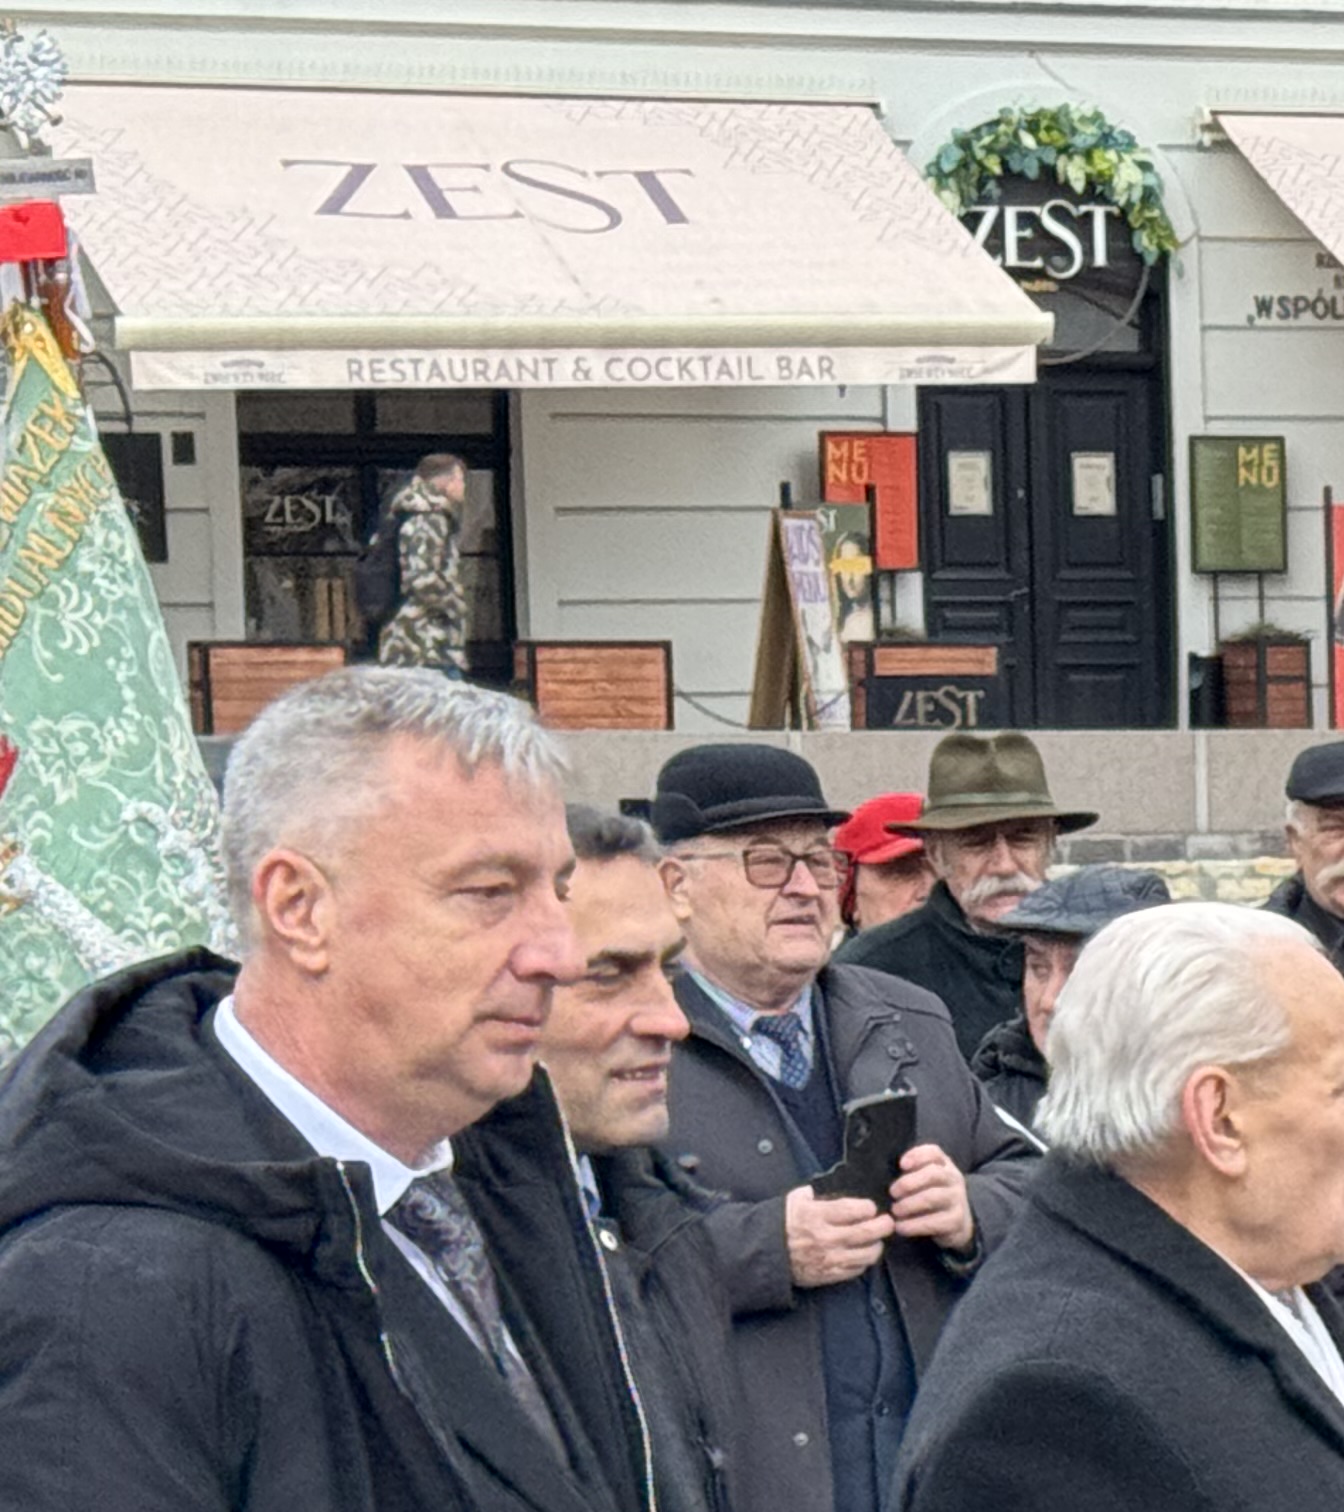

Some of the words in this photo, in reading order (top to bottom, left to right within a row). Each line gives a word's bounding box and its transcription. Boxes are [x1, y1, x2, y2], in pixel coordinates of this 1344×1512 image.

[279, 159, 694, 235] ZEST
[968, 199, 1122, 280] ZEST
[347, 357, 559, 384] RESTAURANT
[571, 357, 593, 382] &
[604, 356, 766, 382] COCKTAIL
[777, 355, 837, 381] BAR
[894, 684, 986, 730] ZEST
